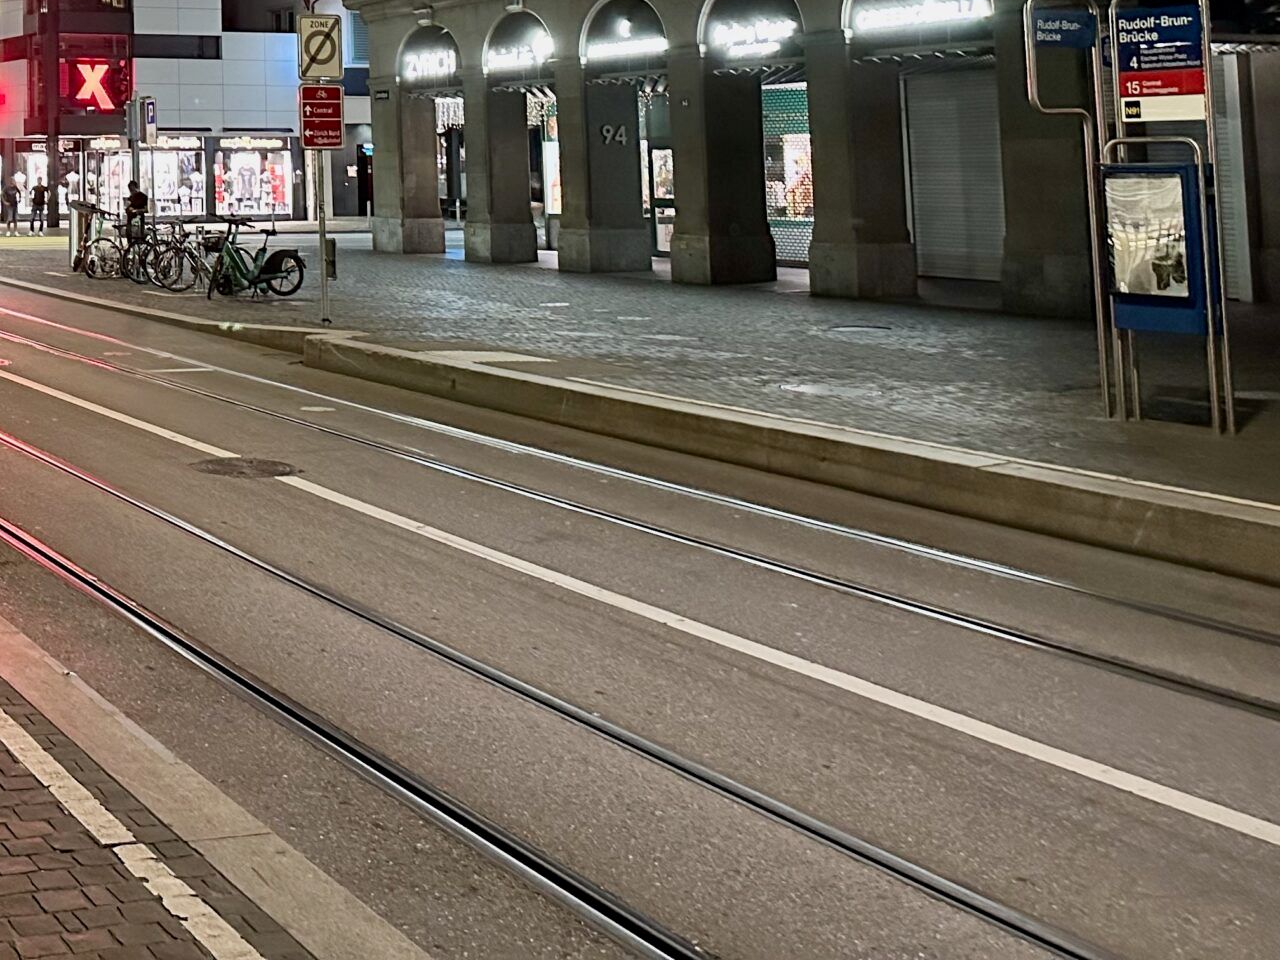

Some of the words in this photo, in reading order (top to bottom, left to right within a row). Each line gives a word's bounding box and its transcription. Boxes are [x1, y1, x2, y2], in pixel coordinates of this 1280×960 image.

[310, 20, 329, 29] ZONE
[1037, 19, 1081, 30] Rudolf-Brun-
[1118, 15, 1193, 30] Rudolf-Brun-
[1036, 30, 1062, 42] Brücke
[1119, 30, 1158, 43] Brücke
[1129, 56, 1139, 70] 4
[75, 64, 116, 110] X
[1126, 80, 1140, 94] 15
[148, 104, 154, 123] P
[313, 106, 333, 114] Central
[1125, 106, 1140, 115] N91
[602, 125, 627, 145] 94
